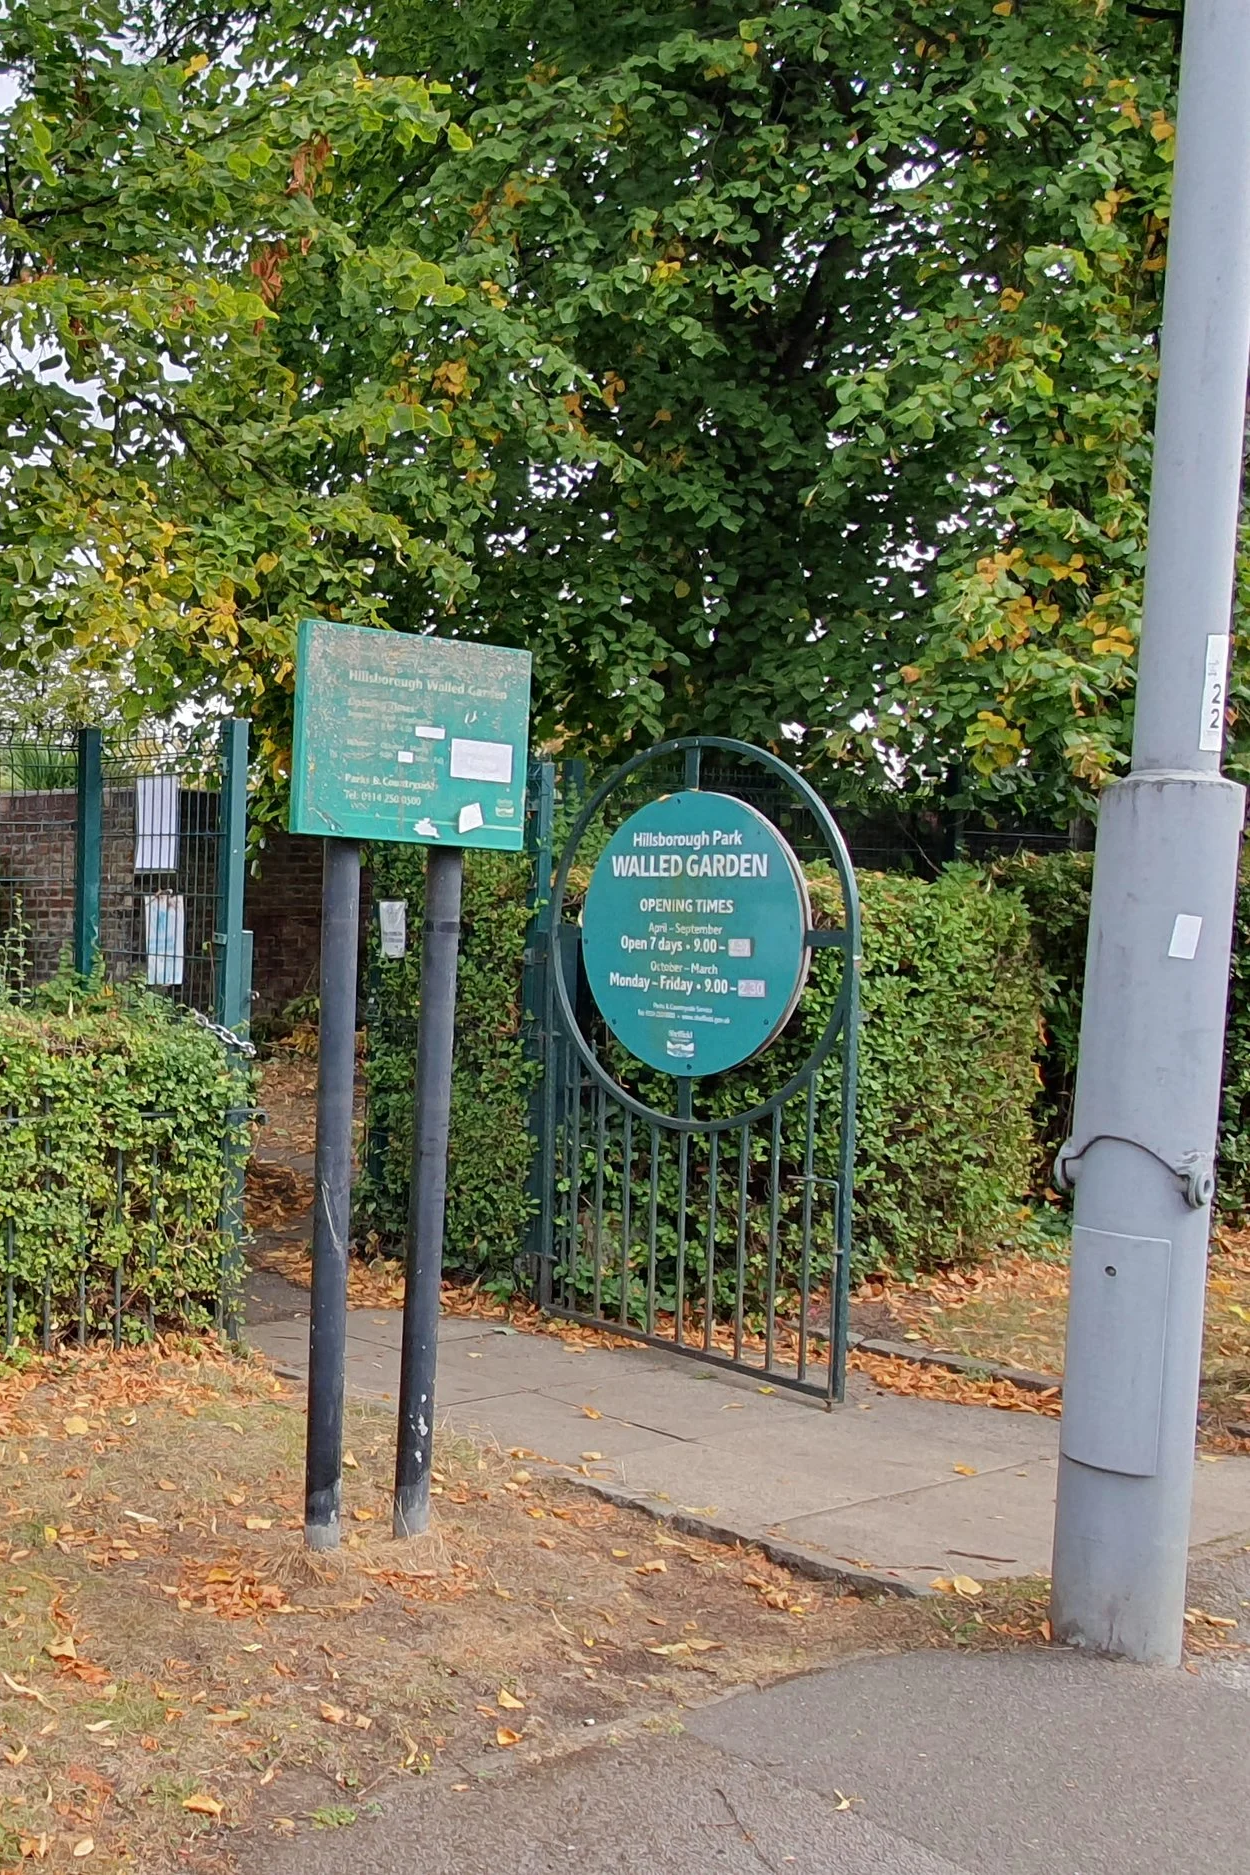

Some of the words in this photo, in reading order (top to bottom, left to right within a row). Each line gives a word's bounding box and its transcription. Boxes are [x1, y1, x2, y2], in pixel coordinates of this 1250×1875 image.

[350, 669, 423, 692] Hillsborough
[427, 679, 465, 695] Walled
[633, 830, 710, 850] Hillsborough
[713, 829, 743, 846] Park
[612, 855, 683, 878] WALLED
[686, 854, 768, 878] GARDEN
[640, 898, 693, 912] OPENING
[696, 899, 734, 914] TIMES
[648, 921, 668, 934] April
[675, 922, 723, 936] September
[620, 935, 648, 953] Open
[650, 936, 657, 950] 7
[658, 936, 683, 955] days
[693, 938, 717, 954] 9.00
[650, 960, 683, 973] October
[690, 963, 718, 975] March
[610, 972, 651, 992] Monday
[660, 975, 693, 996] Friday
[704, 979, 728, 994] 9.00
